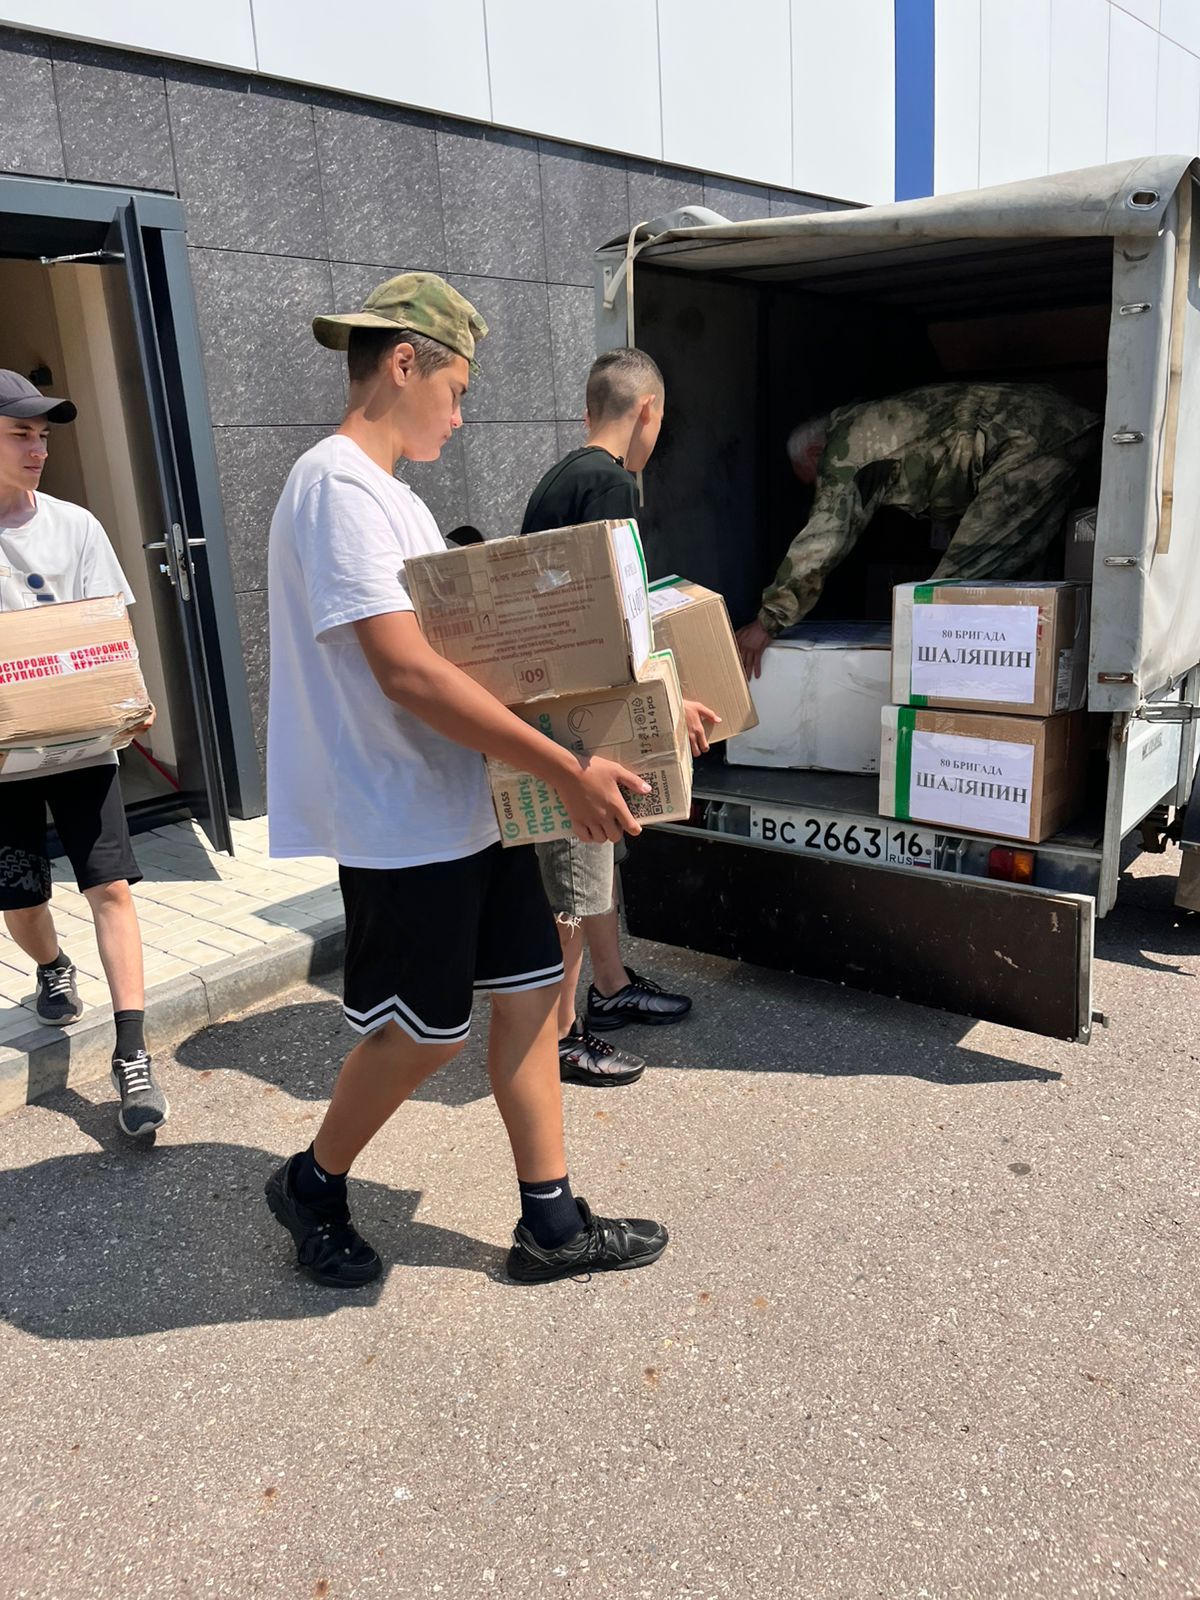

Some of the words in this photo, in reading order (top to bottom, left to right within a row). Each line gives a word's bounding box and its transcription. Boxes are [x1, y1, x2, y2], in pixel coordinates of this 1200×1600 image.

[942, 630, 953, 638] 80
[955, 631, 1006, 642] БРИГАДА
[70, 641, 129, 660] ОСТОРОЖНО
[917, 646, 1032, 668] ШАЛЯПИН
[519, 668, 545, 683] 60г
[646, 696, 656, 710] pcs
[538, 713, 554, 740] ce
[940, 759, 951, 768] 80
[953, 760, 1003, 776] БРИГАДА
[916, 771, 1028, 804] ШАЛЯПИН
[501, 791, 513, 819] GRASS
[539, 805, 555, 833] the
[561, 819, 572, 829] a
[804, 819, 881, 858] 2663
[892, 831, 923, 857] 16
[889, 853, 913, 866] RUS
